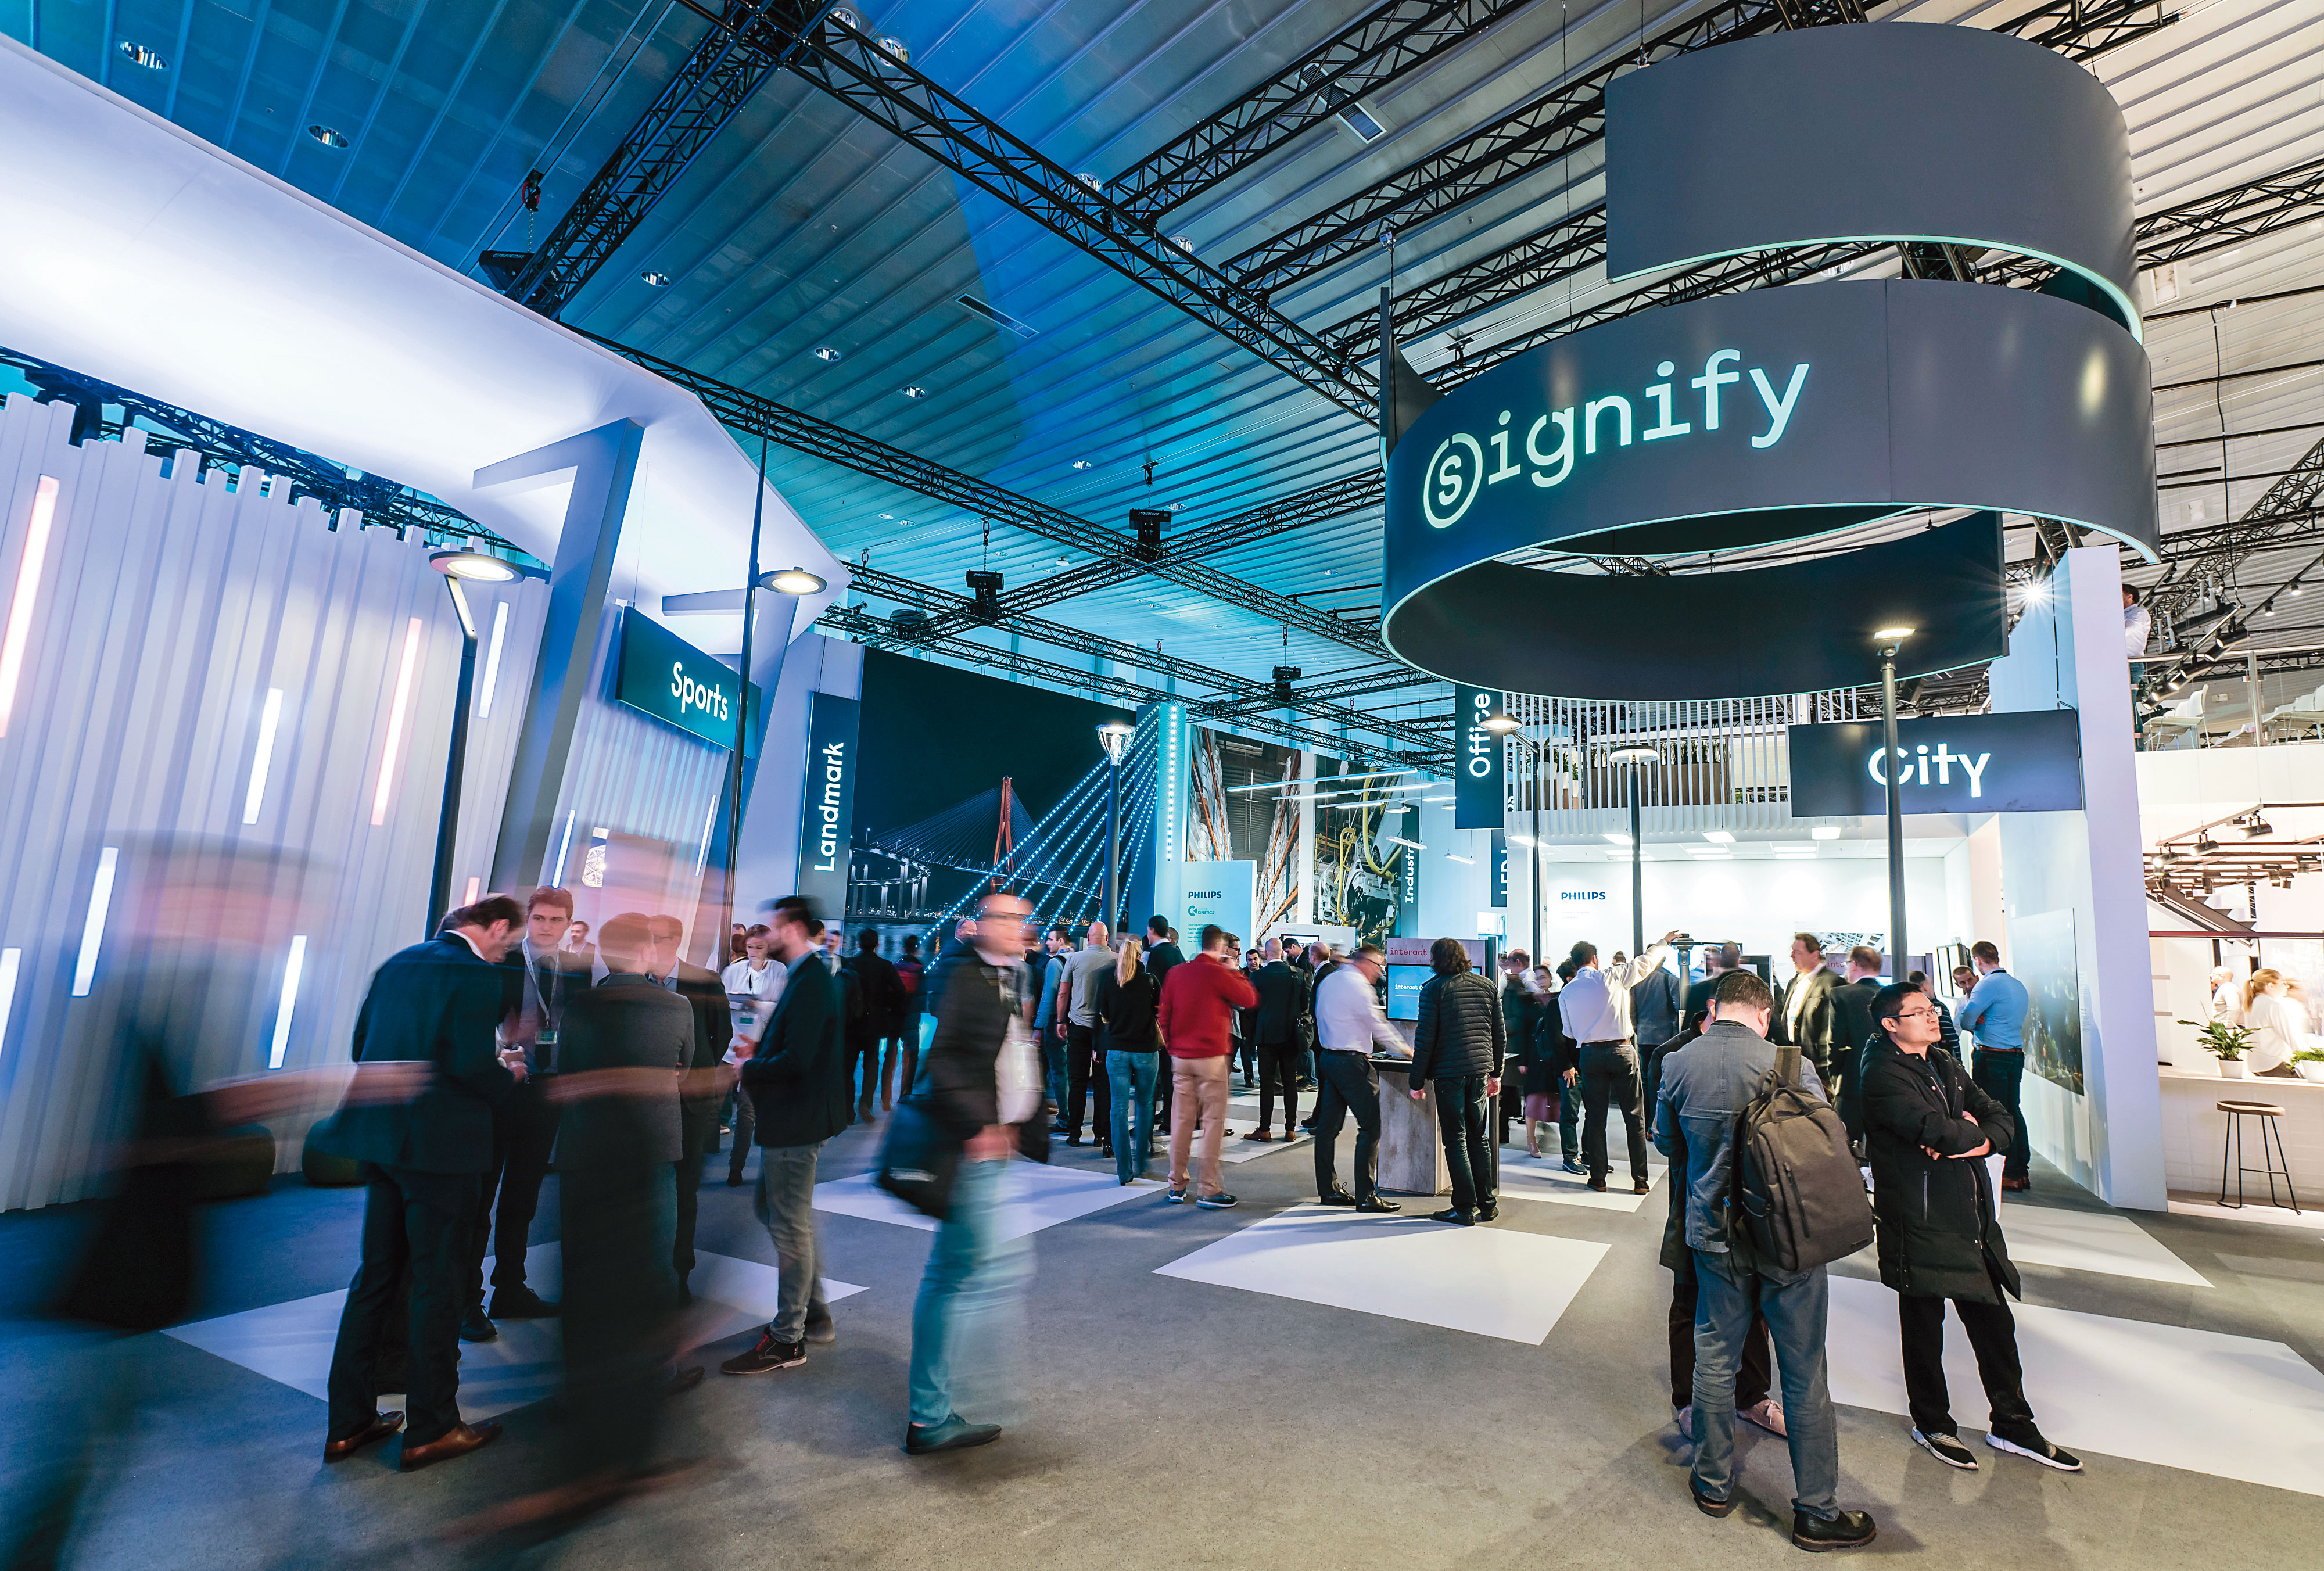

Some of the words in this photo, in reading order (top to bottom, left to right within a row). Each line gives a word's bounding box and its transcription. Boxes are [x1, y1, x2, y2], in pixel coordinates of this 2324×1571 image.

[671, 661, 728, 722] Sports
[1469, 693, 1491, 777] Office
[1868, 743, 1991, 798] City
[814, 742, 844, 871] Landmark
[1188, 891, 1222, 899] PHILIPS
[1561, 892, 1606, 900] PHILIPS
[1390, 948, 1428, 956] interact
